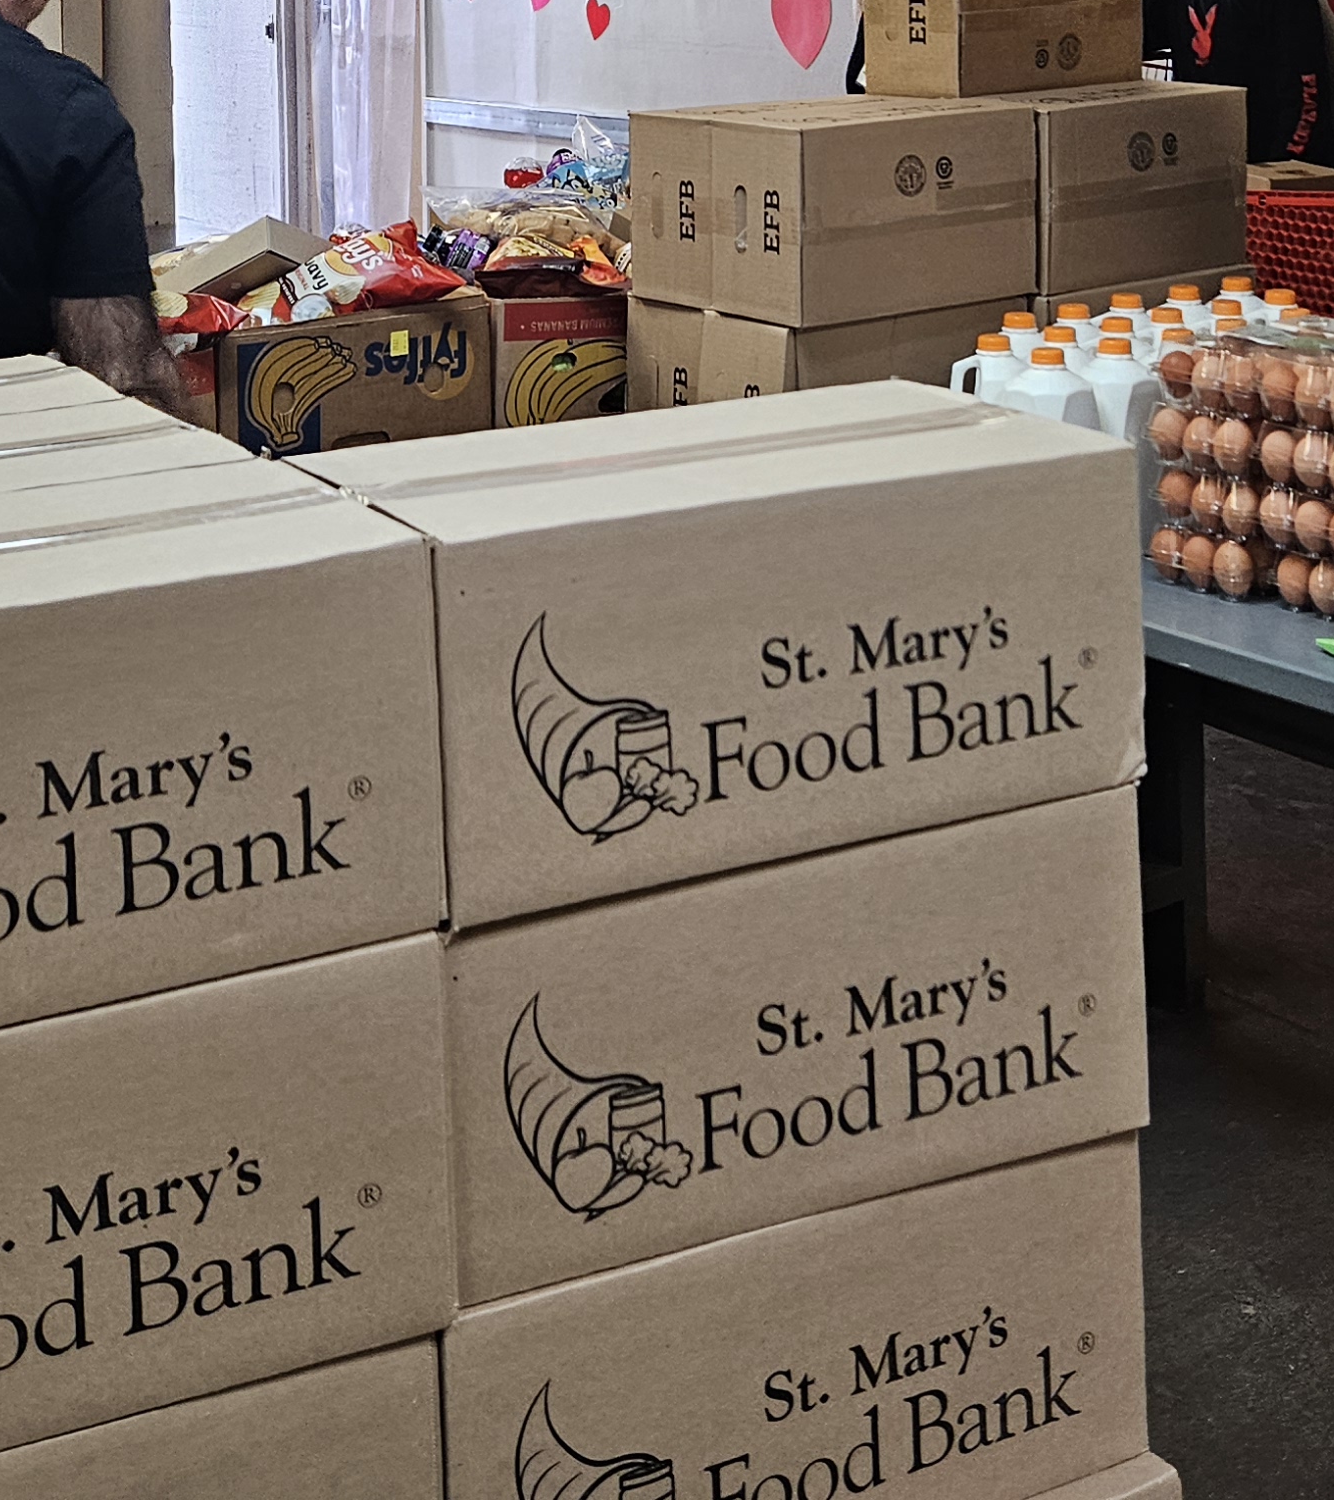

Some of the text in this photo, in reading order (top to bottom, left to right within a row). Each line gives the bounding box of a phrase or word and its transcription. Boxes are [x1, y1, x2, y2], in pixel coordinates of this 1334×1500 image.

[679, 179, 696, 242] EFB
[763, 189, 781, 255] EFB
[530, 319, 578, 333] BANANAS
[672, 366, 689, 407] FB
[761, 606, 1009, 690] St. Mary's
[35, 731, 253, 820] Mary's
[701, 654, 1082, 803] Food Bank
[111, 786, 351, 917] Bank
[756, 957, 1007, 1056] St. Mary's
[694, 1004, 1082, 1175] Food Bank
[43, 1146, 262, 1245] Mary's
[119, 1196, 361, 1337] Bank
[764, 1306, 1009, 1423] St. Mary's
[903, 1346, 1081, 1475] Bank
